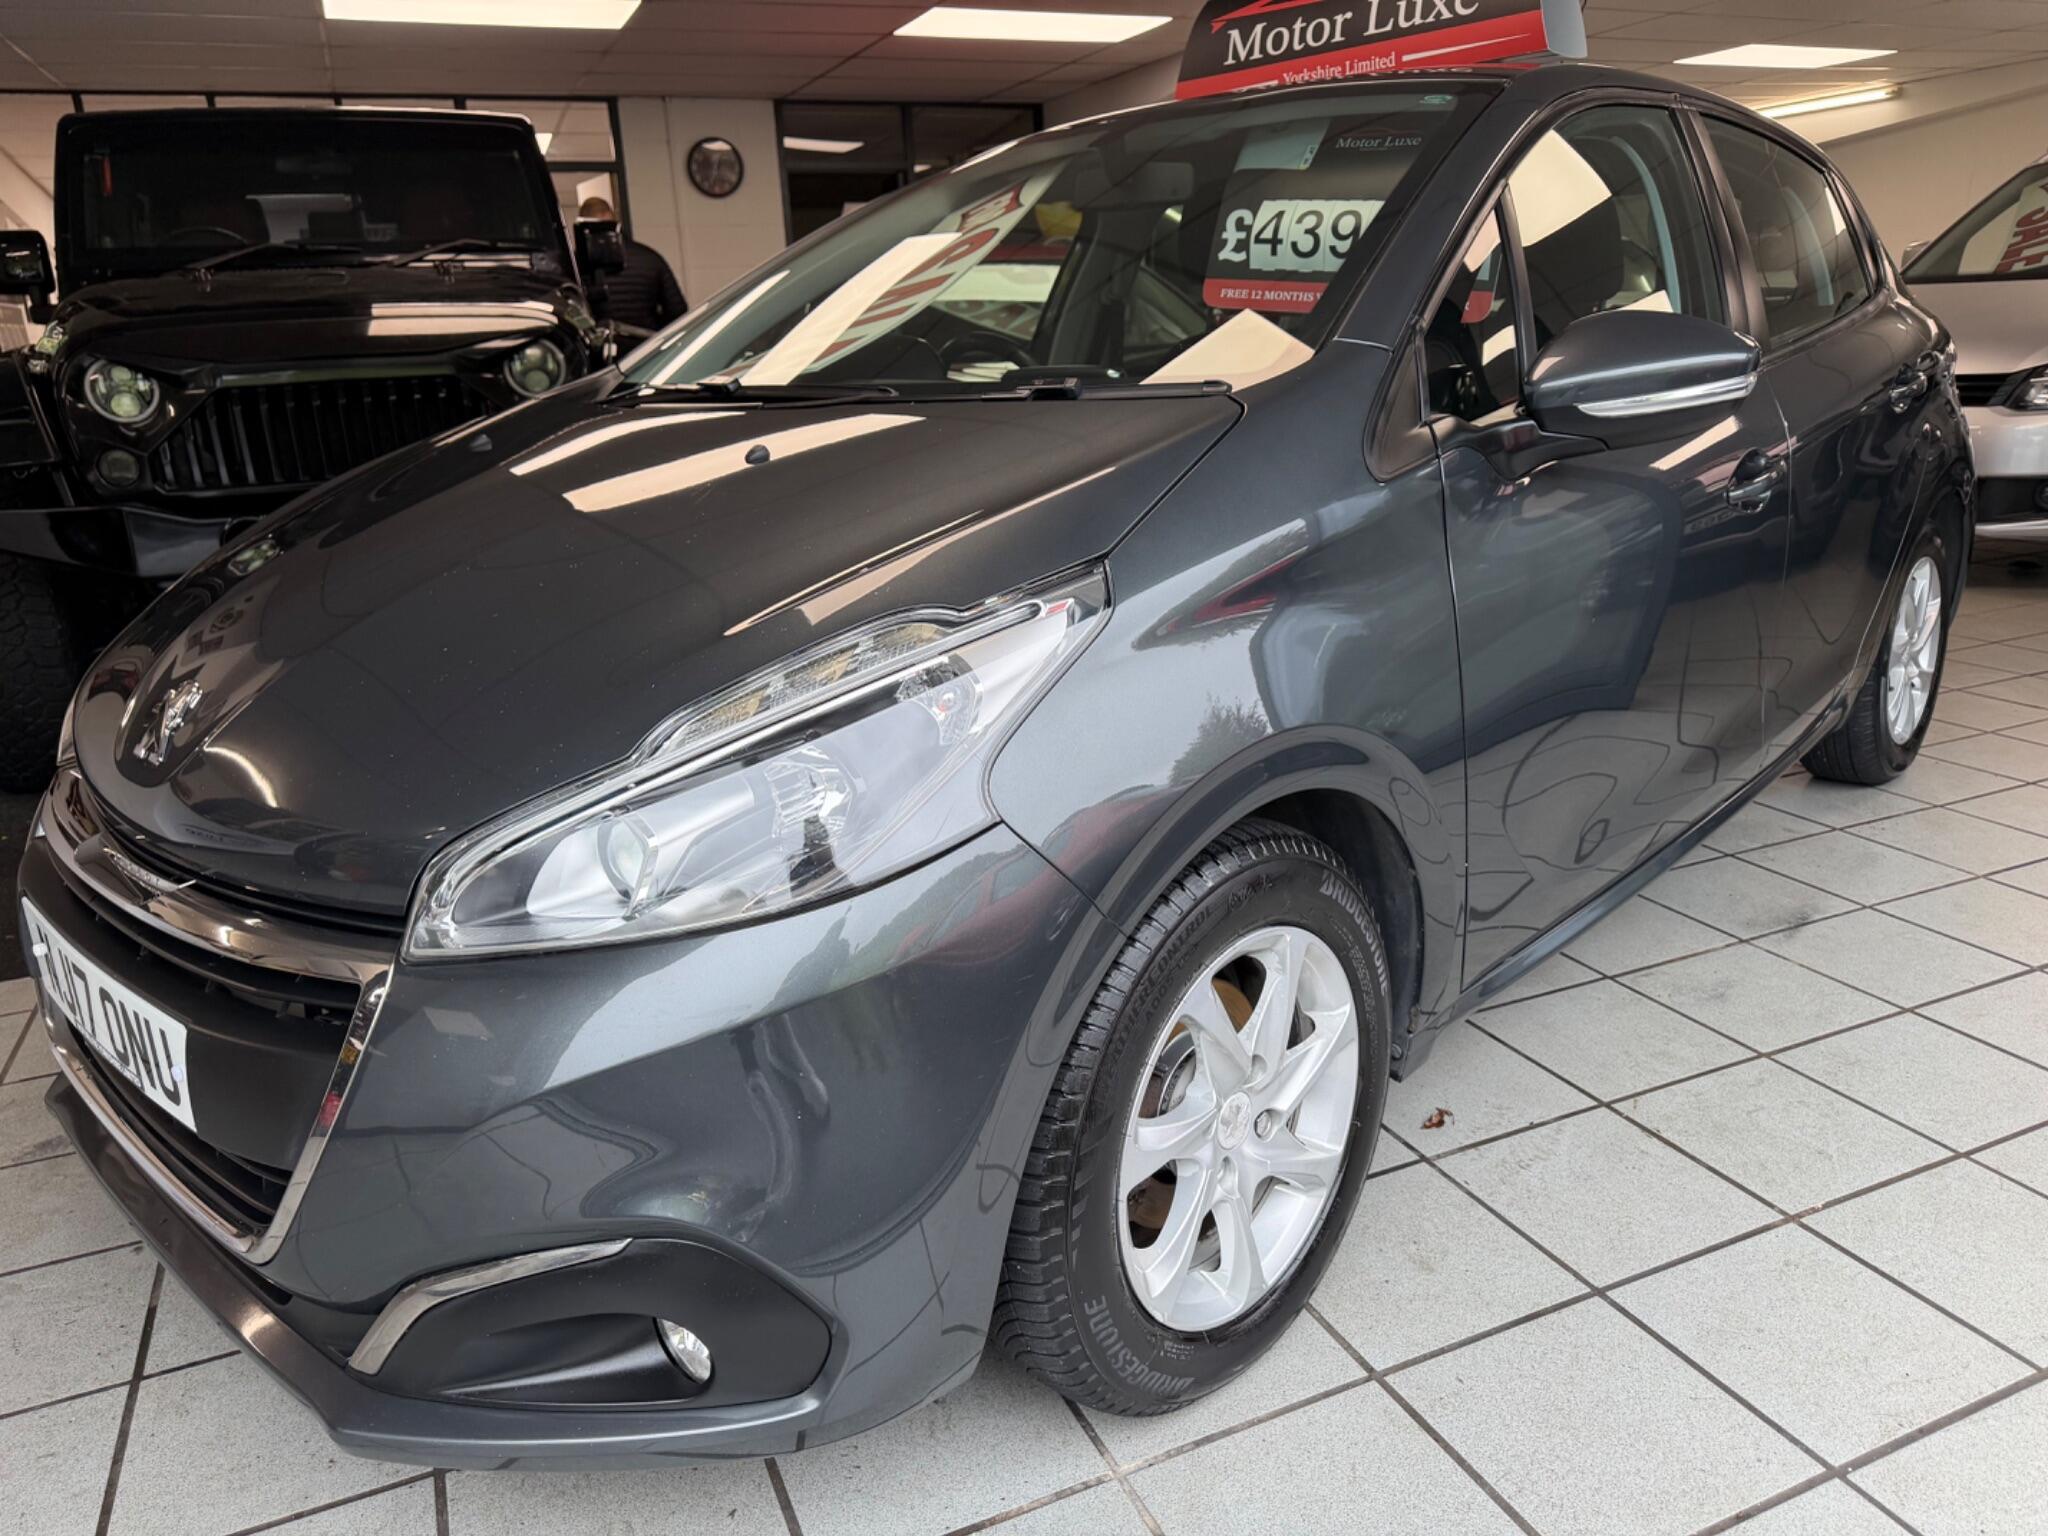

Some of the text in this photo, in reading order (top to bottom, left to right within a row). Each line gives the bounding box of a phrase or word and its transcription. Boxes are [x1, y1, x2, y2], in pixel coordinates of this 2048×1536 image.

[1224, 0, 1479, 66] Motor Luxe
[1283, 52, 1396, 86] Yorkshire Limited
[1335, 135, 1422, 149] Motor Luxe
[1220, 288, 1249, 300] FREE
[1251, 289, 1262, 300] 12
[1263, 289, 1314, 302] MONTHS
[1319, 868, 1389, 997] BRIDGESTONE
[98, 985, 182, 1107] ONU
[1084, 1295, 1196, 1394] BRIDGESTONE
